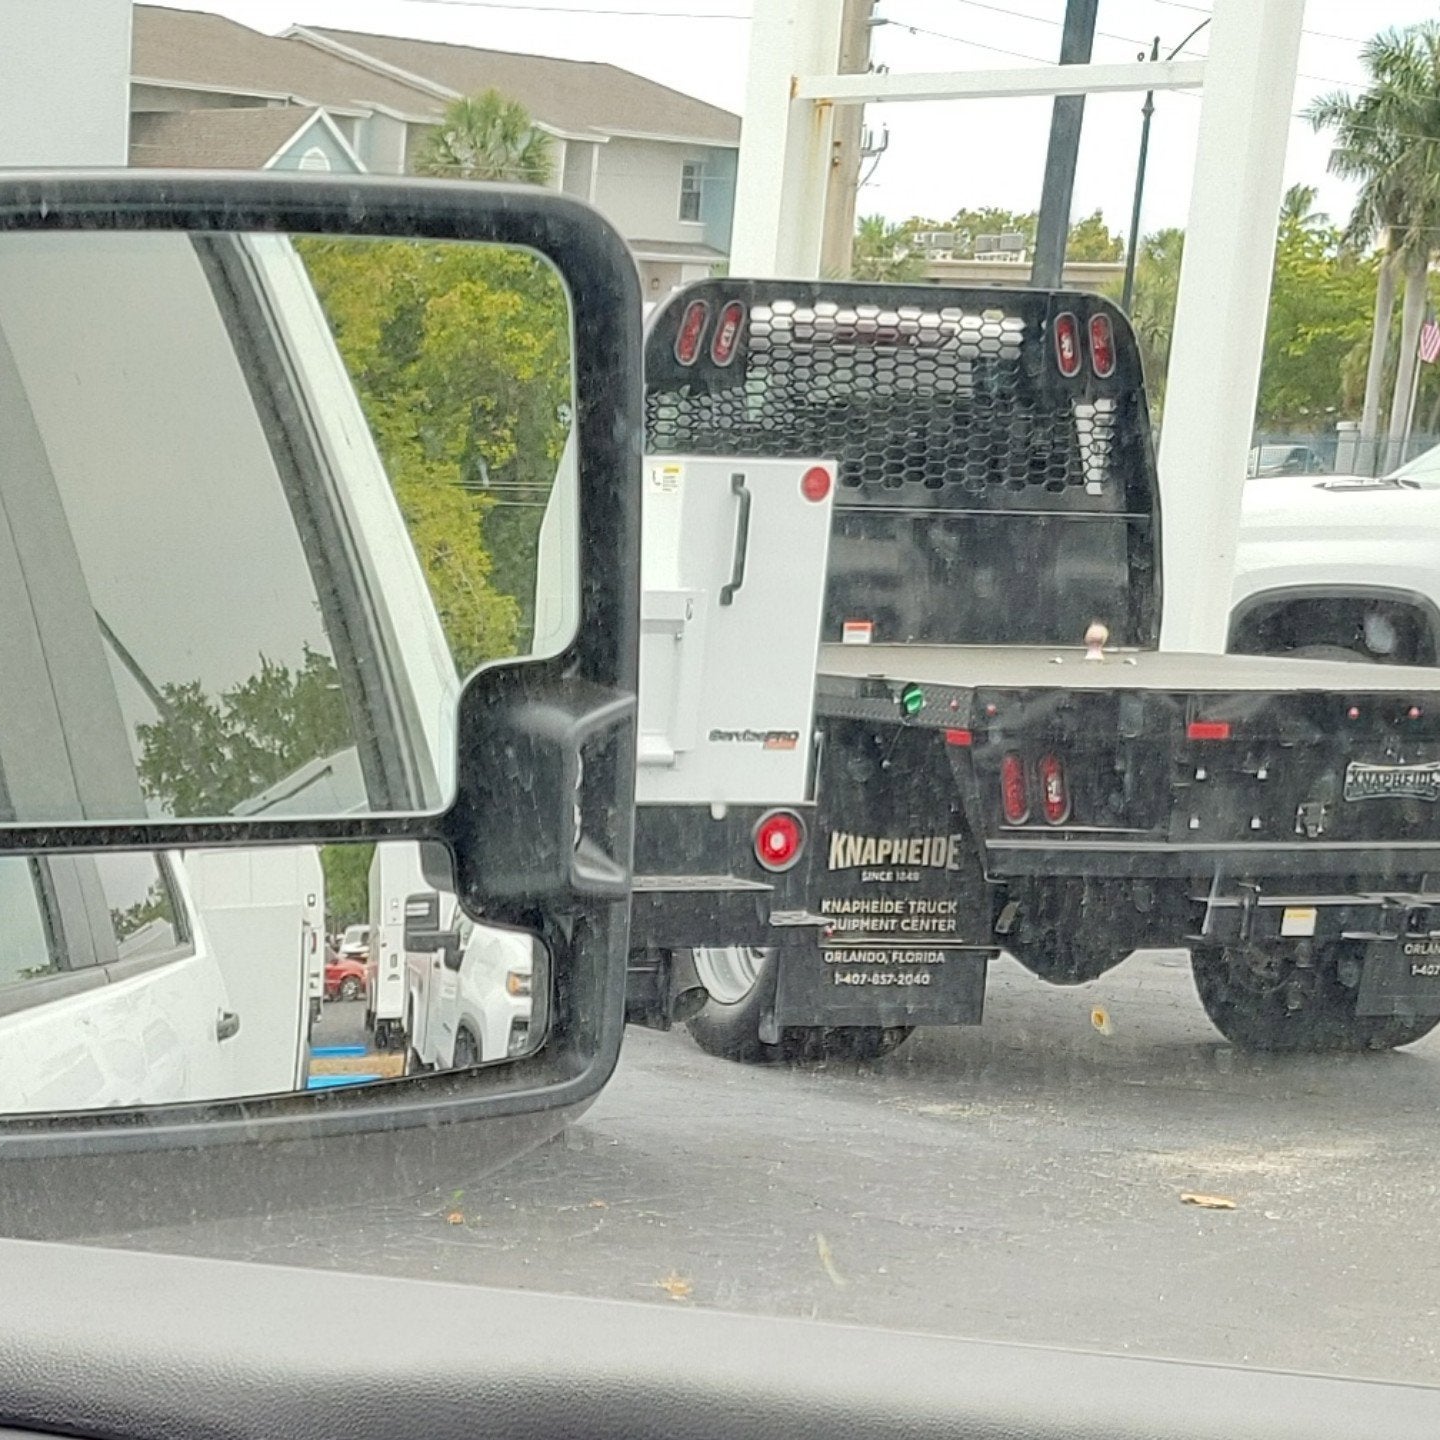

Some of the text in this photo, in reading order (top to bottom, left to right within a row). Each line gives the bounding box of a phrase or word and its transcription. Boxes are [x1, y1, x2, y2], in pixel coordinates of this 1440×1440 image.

[828, 830, 962, 871] KNAPHEIDE
[822, 900, 958, 914] KNAPHEIDE TRUCK
[828, 917, 956, 932] QUIPMENT CENTER
[824, 951, 946, 965] ORLANDO, FLORIDA
